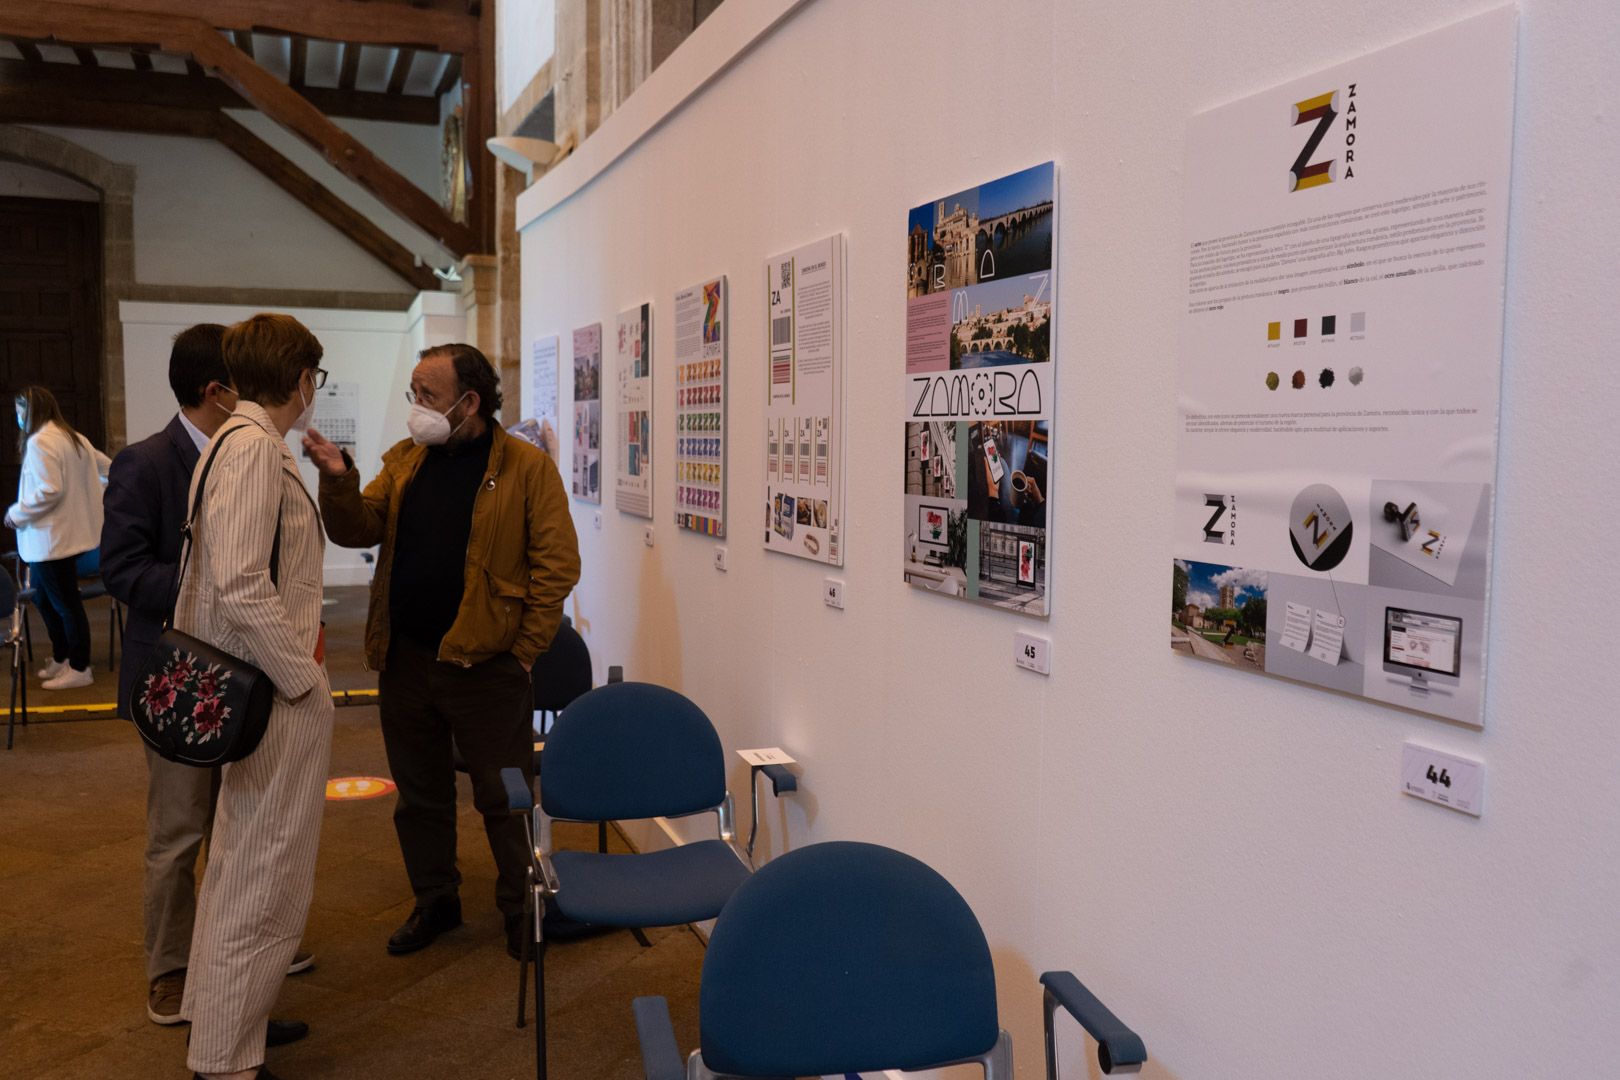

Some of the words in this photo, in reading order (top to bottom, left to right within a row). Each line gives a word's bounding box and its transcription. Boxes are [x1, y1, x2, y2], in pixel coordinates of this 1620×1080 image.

[1344, 83, 1357, 180] ZAMORA
[912, 369, 1042, 417] ZAMORA
[1024, 644, 1036, 659] 45
[1426, 764, 1451, 789] 44
